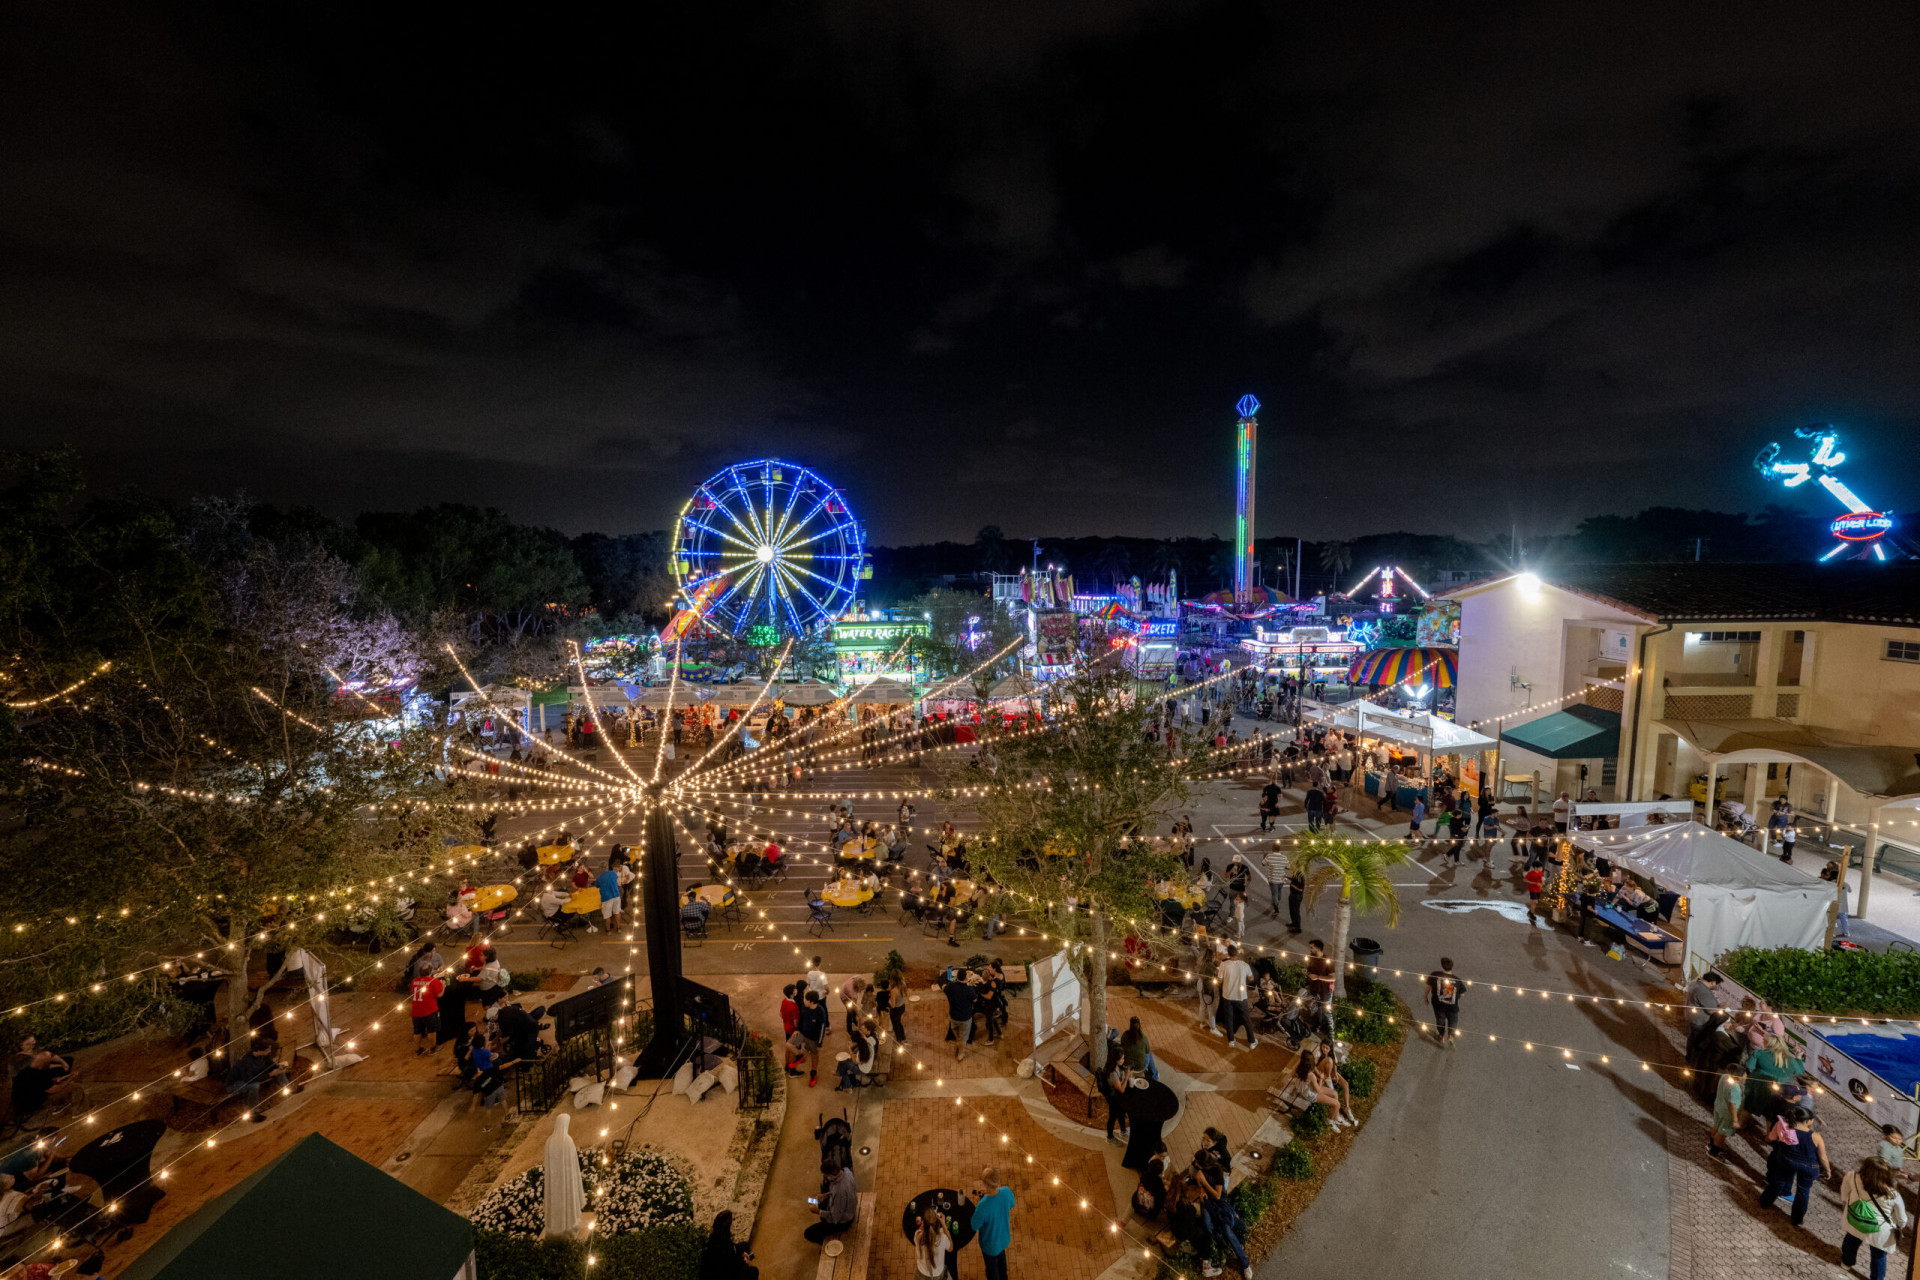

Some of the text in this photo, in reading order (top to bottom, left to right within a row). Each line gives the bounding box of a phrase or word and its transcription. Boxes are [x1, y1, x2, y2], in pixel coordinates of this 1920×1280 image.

[838, 628, 923, 639] WATER RACE FUN
[1141, 623, 1176, 635] TICKETS
[1580, 815, 1593, 823] 90
[732, 943, 756, 951] PK
[412, 987, 425, 1002] 11
